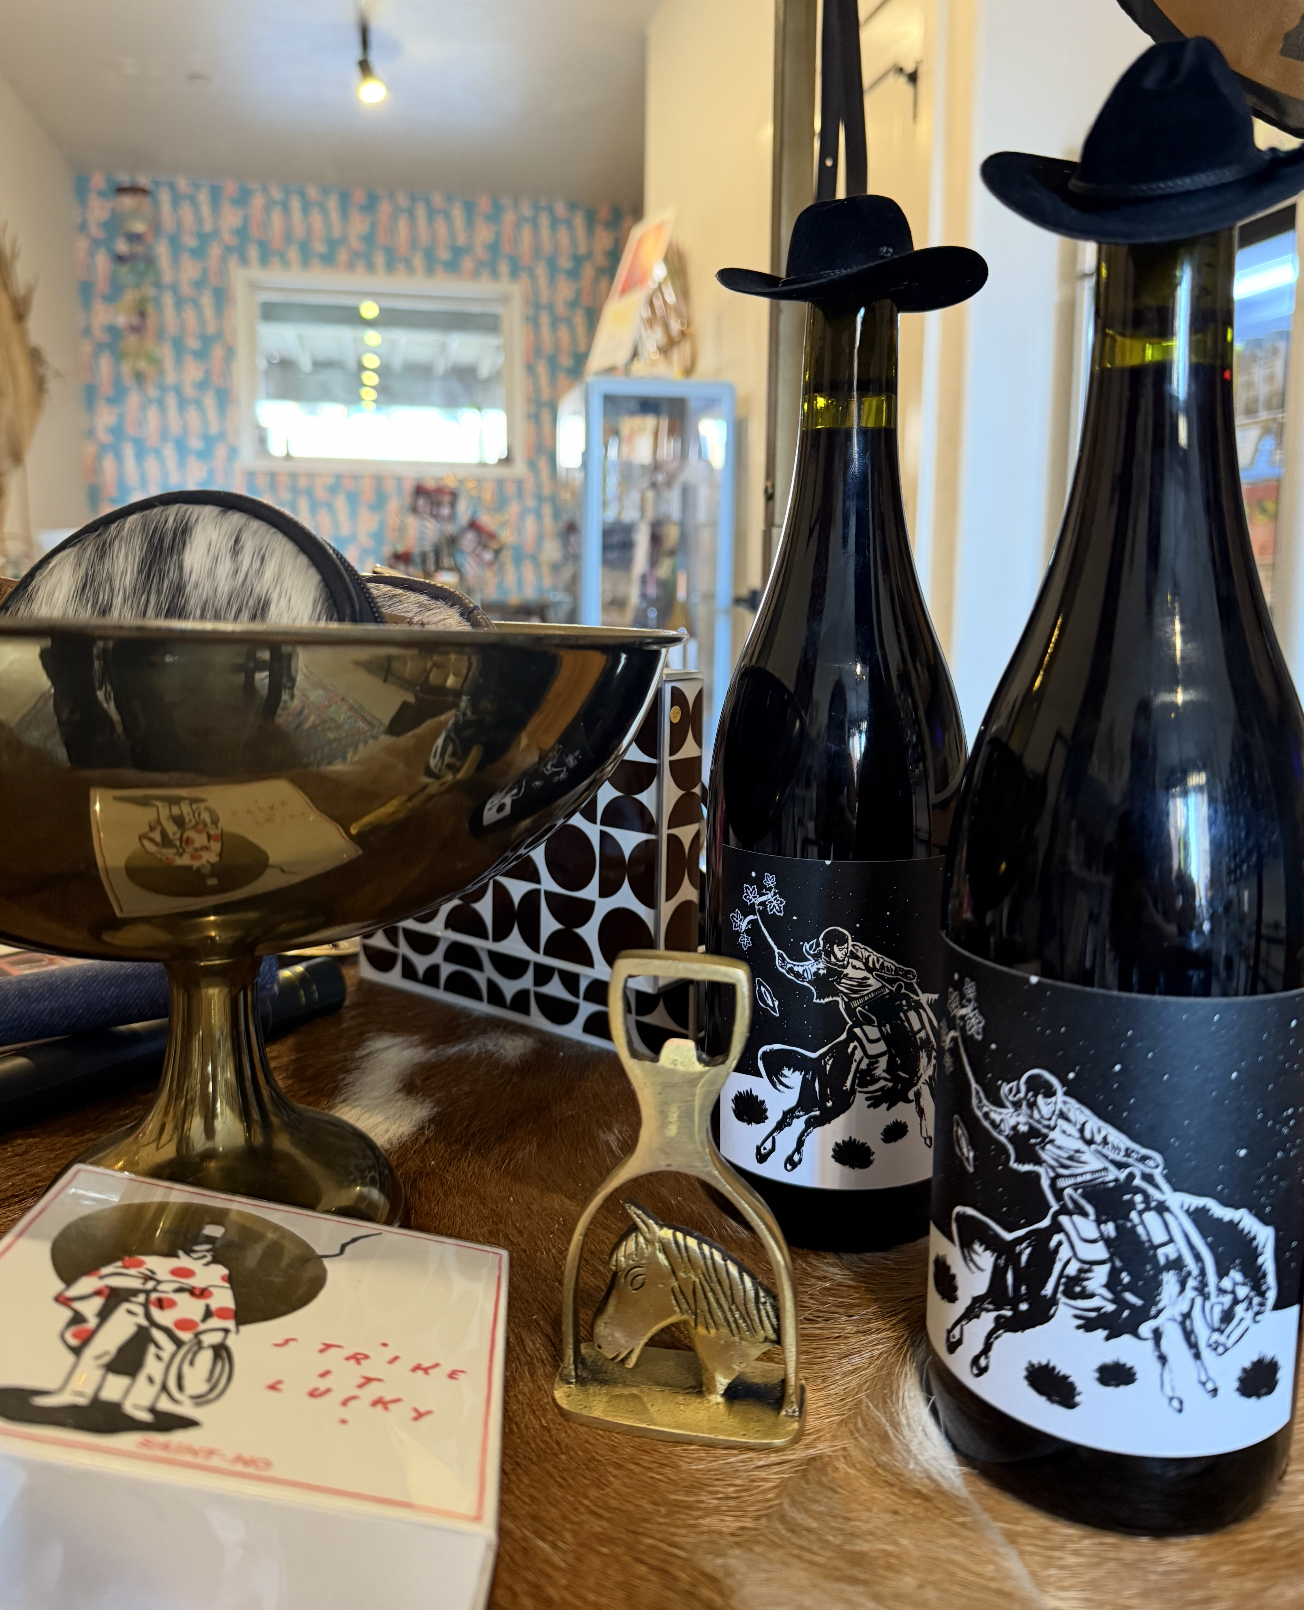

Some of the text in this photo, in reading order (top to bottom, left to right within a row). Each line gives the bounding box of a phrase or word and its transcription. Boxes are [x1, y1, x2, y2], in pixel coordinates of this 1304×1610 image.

[272, 1337, 467, 1380] STRIKE
[317, 1369, 385, 1389] IT
[265, 1379, 434, 1422] LUCKY
